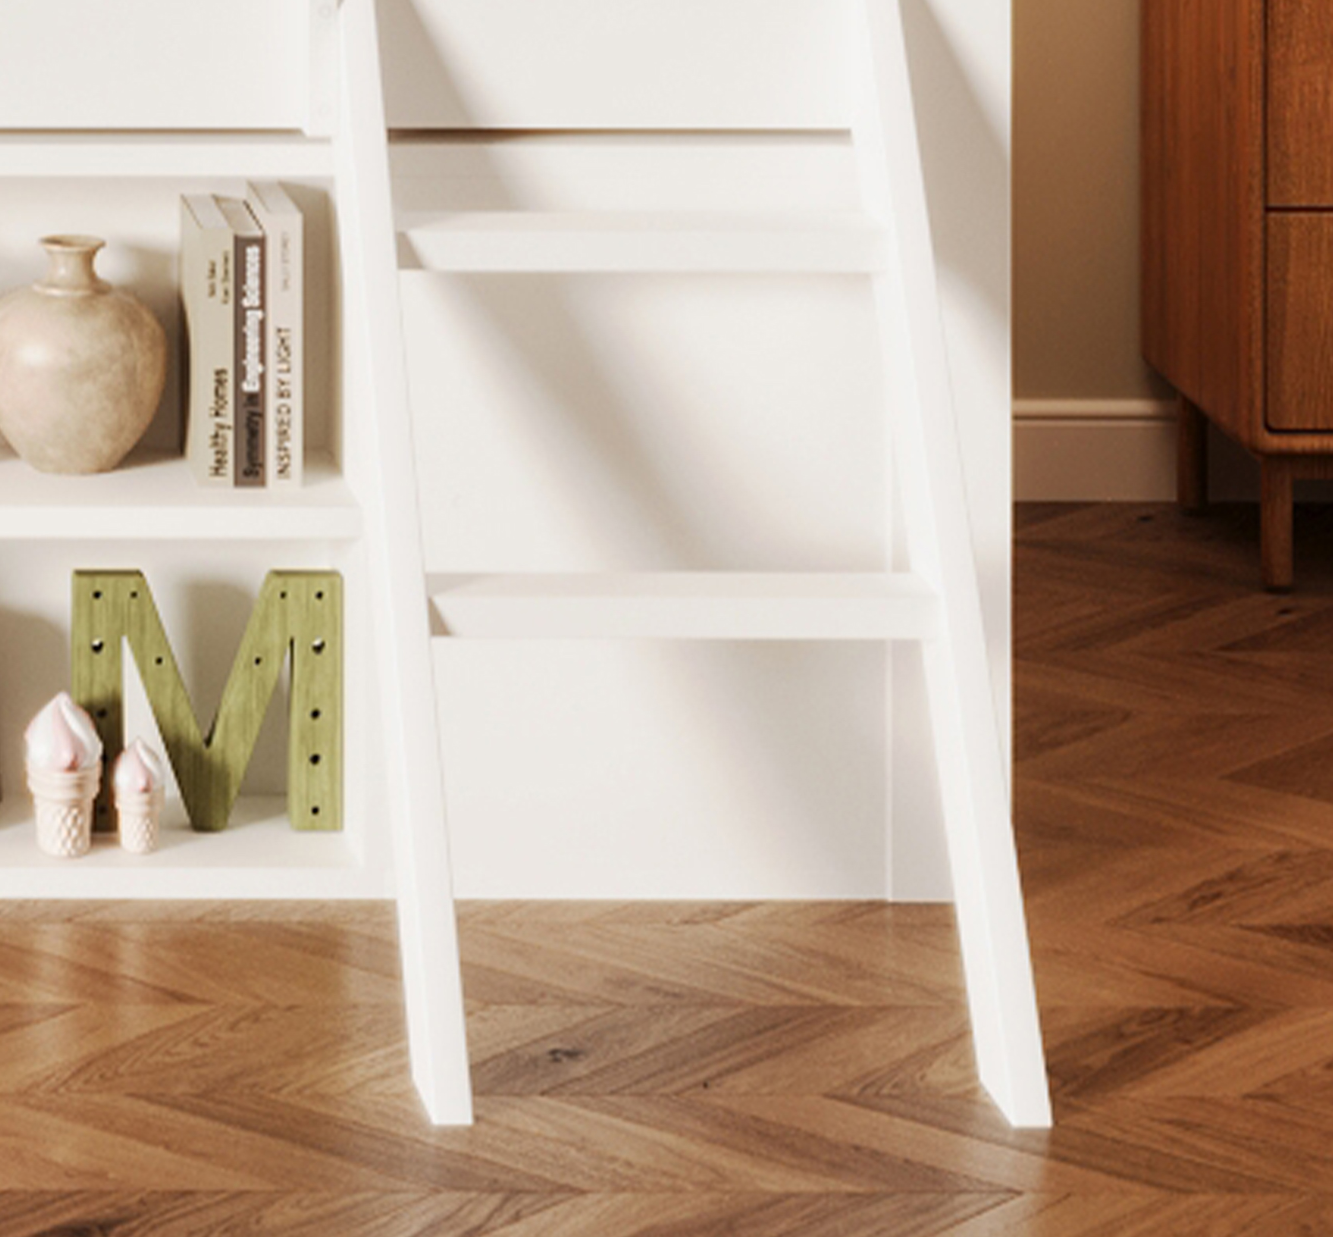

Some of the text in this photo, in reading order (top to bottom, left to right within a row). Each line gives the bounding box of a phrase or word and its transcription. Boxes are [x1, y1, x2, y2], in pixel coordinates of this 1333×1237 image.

[241, 245, 261, 308] Sciences
[241, 309, 264, 393] Engineering
[209, 368, 232, 478] Healthy Homes
[276, 325, 291, 480] INSPIRED BY LIGHT
